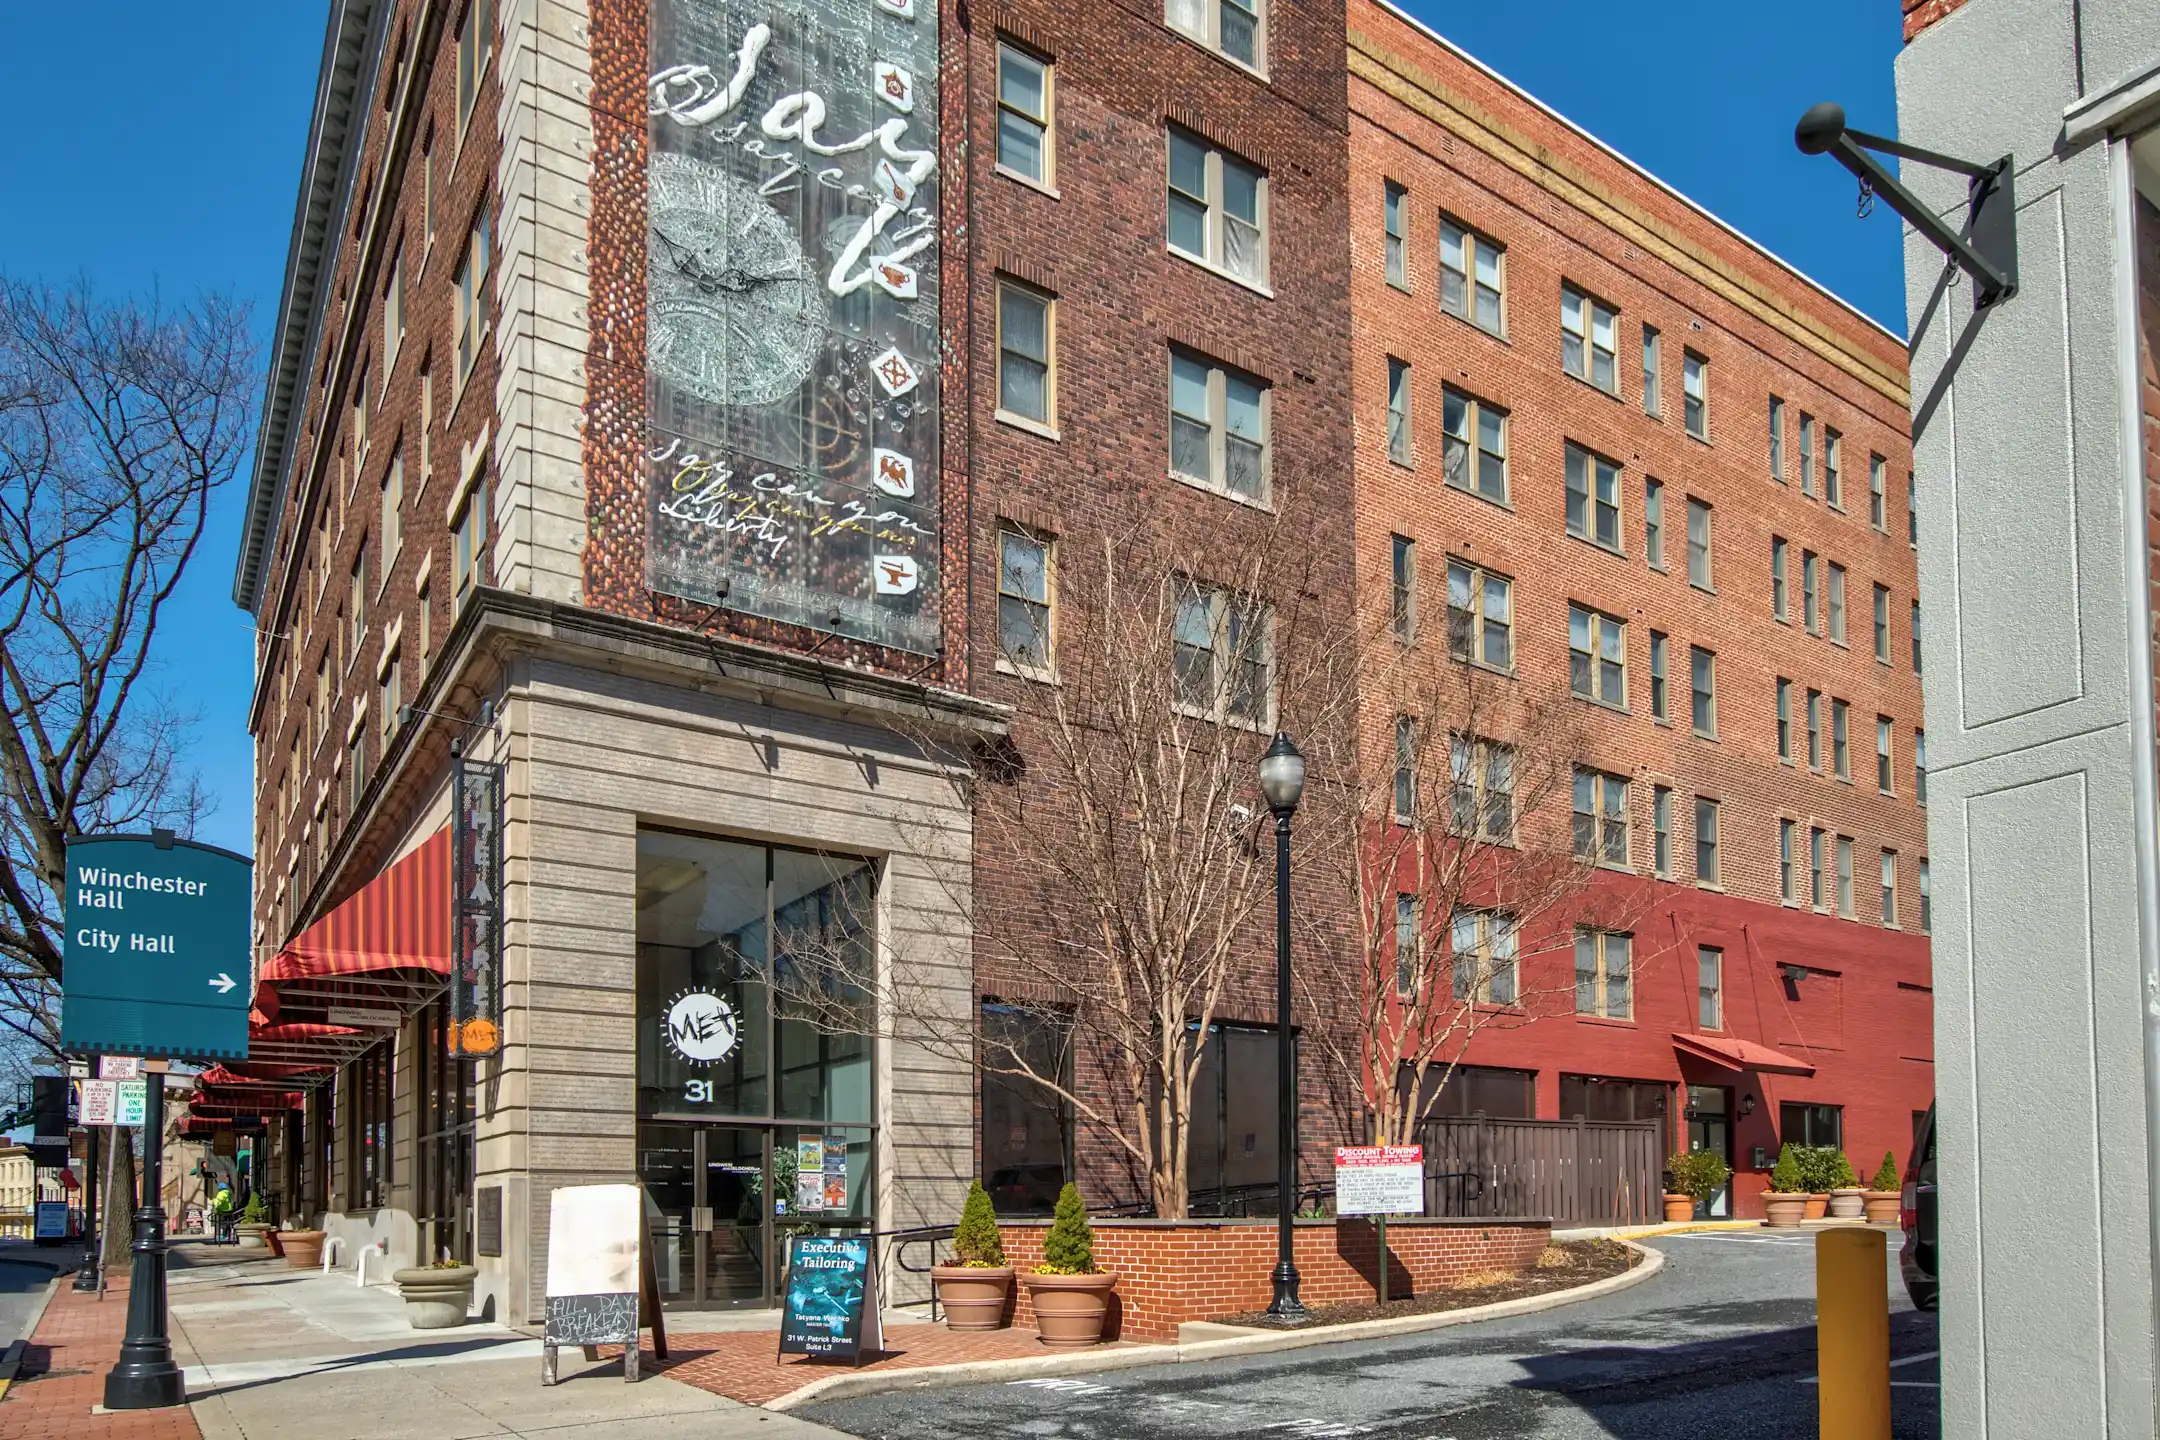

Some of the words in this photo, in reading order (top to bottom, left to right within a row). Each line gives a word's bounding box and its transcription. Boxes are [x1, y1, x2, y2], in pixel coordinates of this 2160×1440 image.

[658, 492, 788, 560] Liberty
[78, 866, 208, 896] Winchester
[469, 774, 493, 1005] THEATRE
[77, 888, 124, 910] Hall
[77, 928, 121, 954] City
[130, 933, 176, 954] Hall
[120, 1084, 148, 1092] SATURDA
[684, 1079, 713, 1103] 31
[125, 1107, 143, 1115] HOUR
[1337, 1146, 1381, 1157] DISCOUNT
[1382, 1145, 1420, 1156] TOWING
[801, 1241, 860, 1254] Executive
[802, 1256, 856, 1273] Tailoring
[594, 1294, 634, 1313] DAY
[795, 1313, 821, 1322] Tatyana
[787, 1334, 796, 1342] 31
[797, 1334, 807, 1342] W.
[808, 1335, 830, 1343] Patrick
[831, 1336, 853, 1344] Street
[805, 1342, 822, 1351] Suite
[823, 1343, 833, 1351] L3
